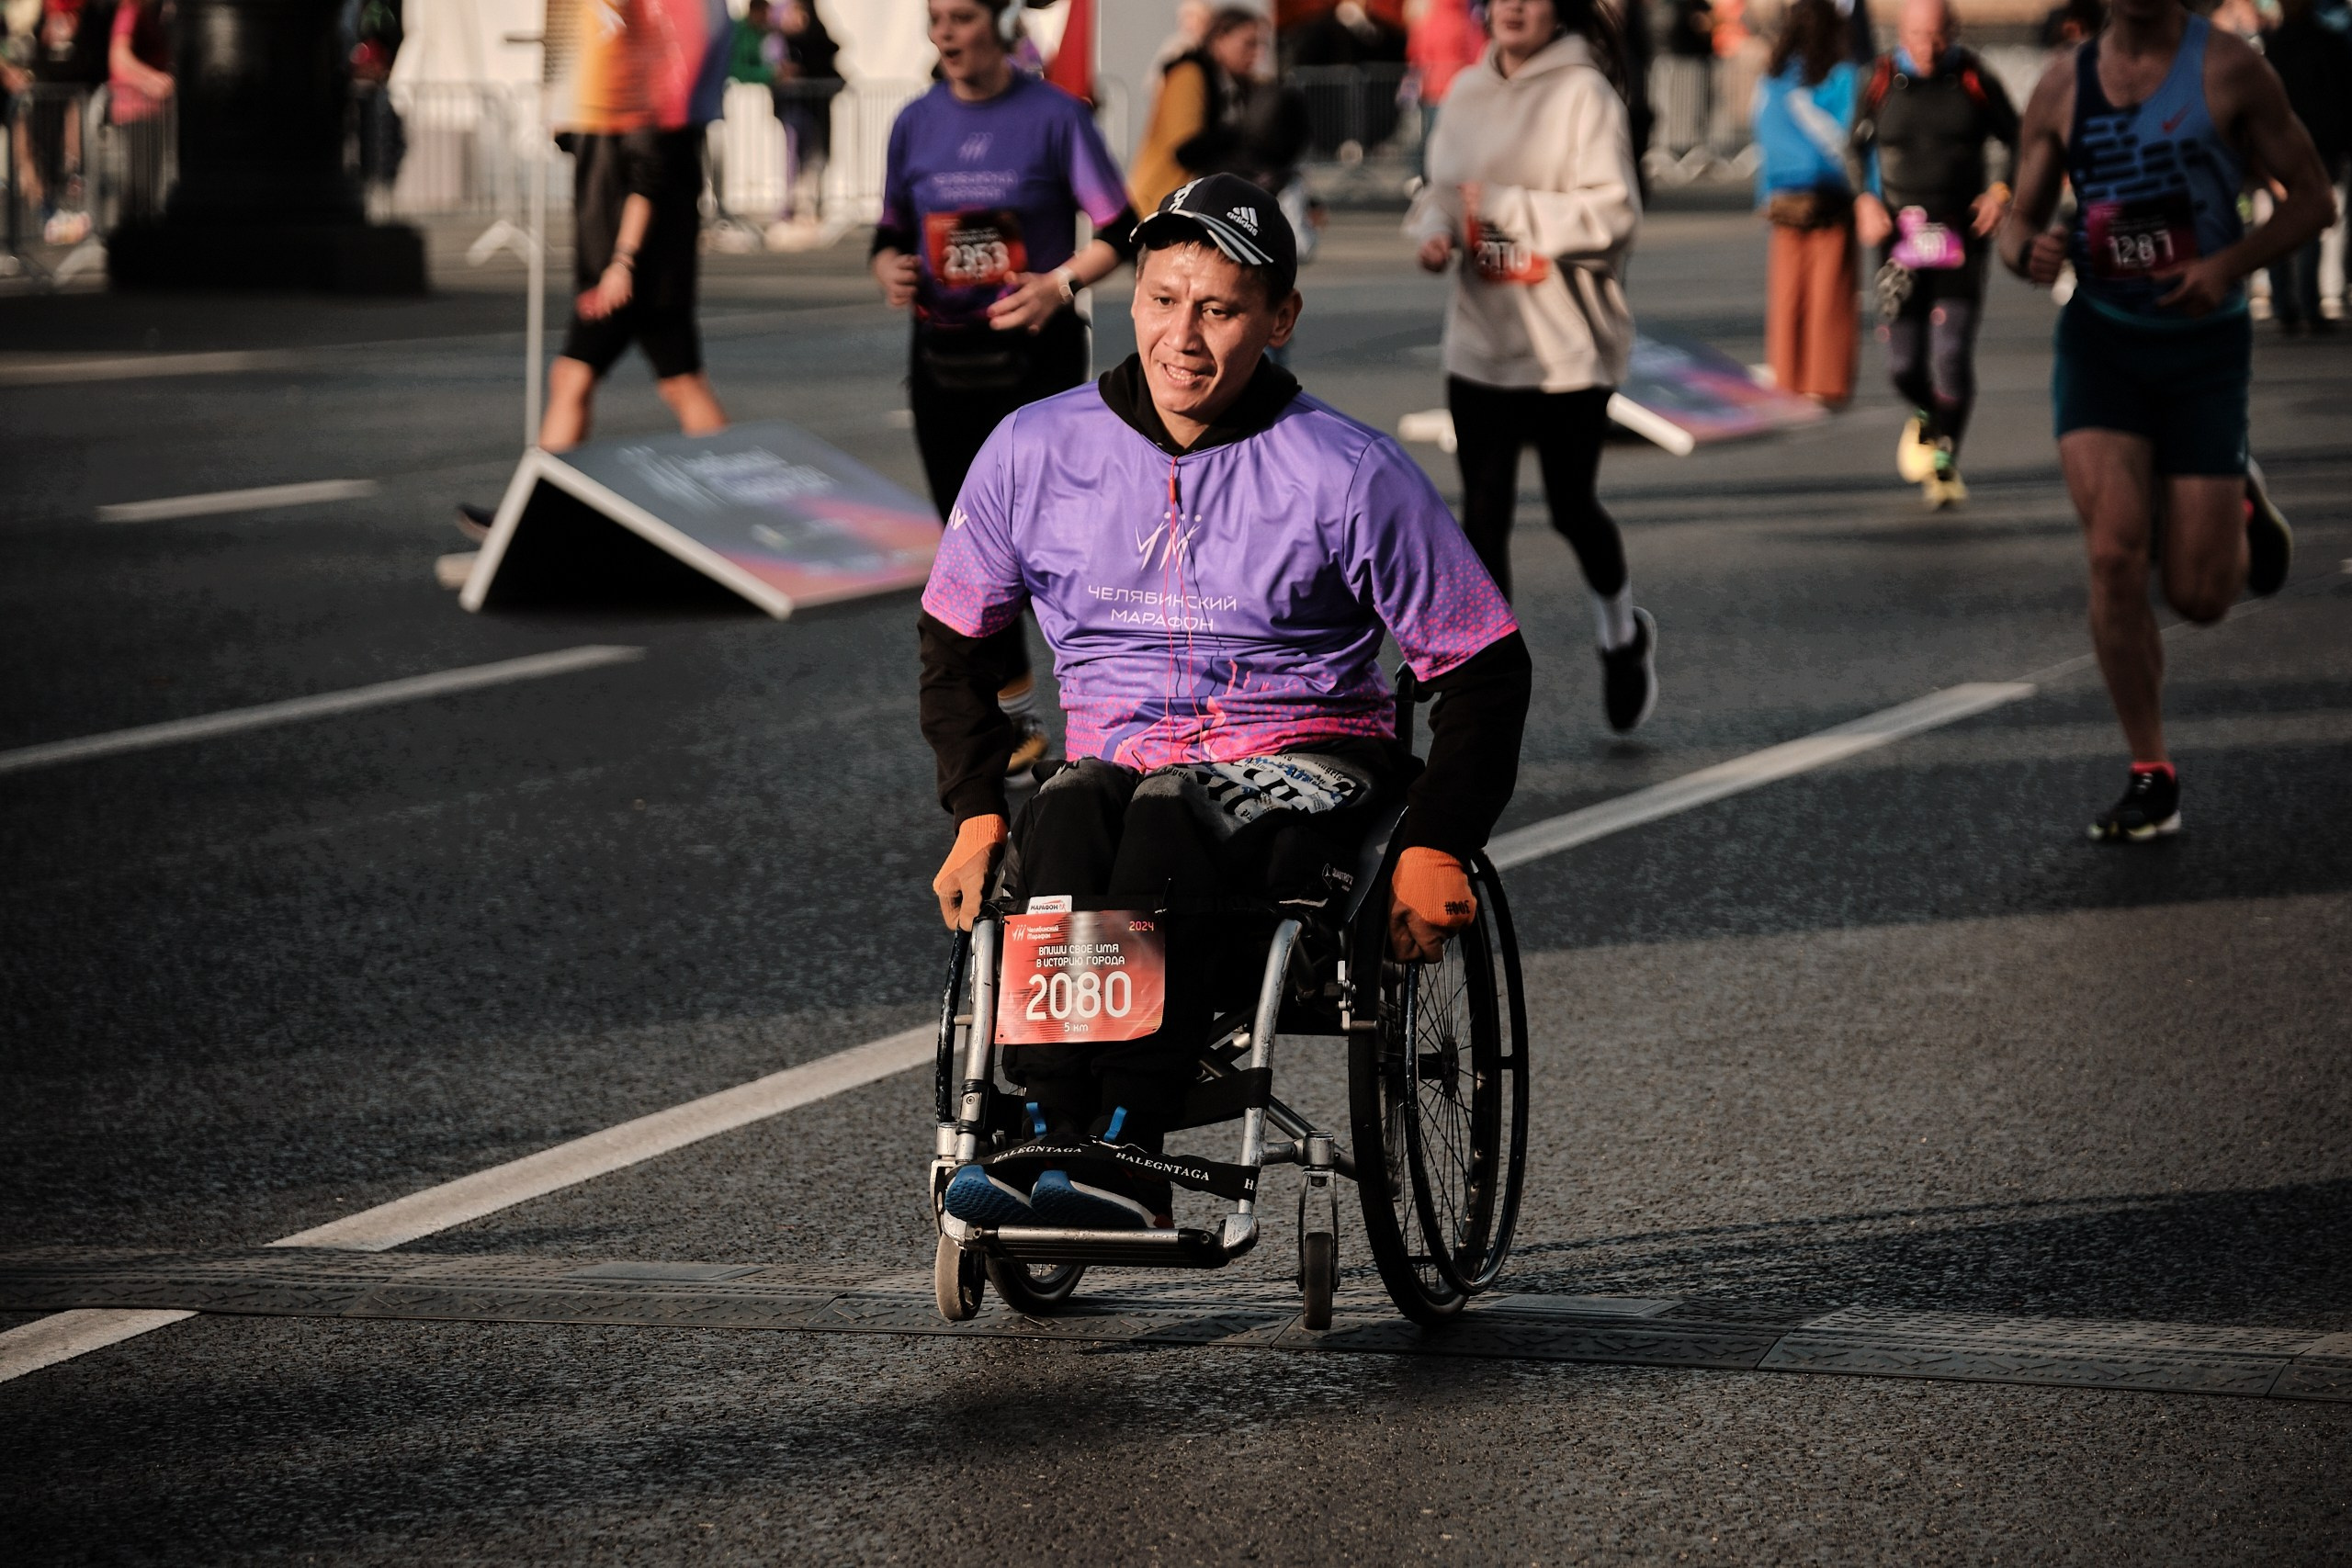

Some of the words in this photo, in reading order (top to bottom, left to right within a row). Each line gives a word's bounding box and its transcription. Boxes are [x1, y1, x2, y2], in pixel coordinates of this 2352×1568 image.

[1227, 211, 1259, 236] adidas
[1088, 585, 1238, 612] ЧЕЛЯБИНСКИЙ
[1111, 609, 1214, 631] МАРАФОН
[1128, 920, 1154, 931] 2024
[1038, 945, 1067, 956] ВПИШИ
[1069, 943, 1093, 954] СВОЕ
[1095, 943, 1119, 953] ИМЯ
[1035, 958, 1042, 968] В
[1043, 956, 1083, 967] ИСТОРИЮ
[1086, 955, 1125, 966] ГОРОДА
[1025, 970, 1132, 1021] 2080
[1064, 1021, 1070, 1032] 5
[992, 1145, 1082, 1164] HALEGNTAGA
[1115, 1152, 1210, 1181] HALEGNTAGA
